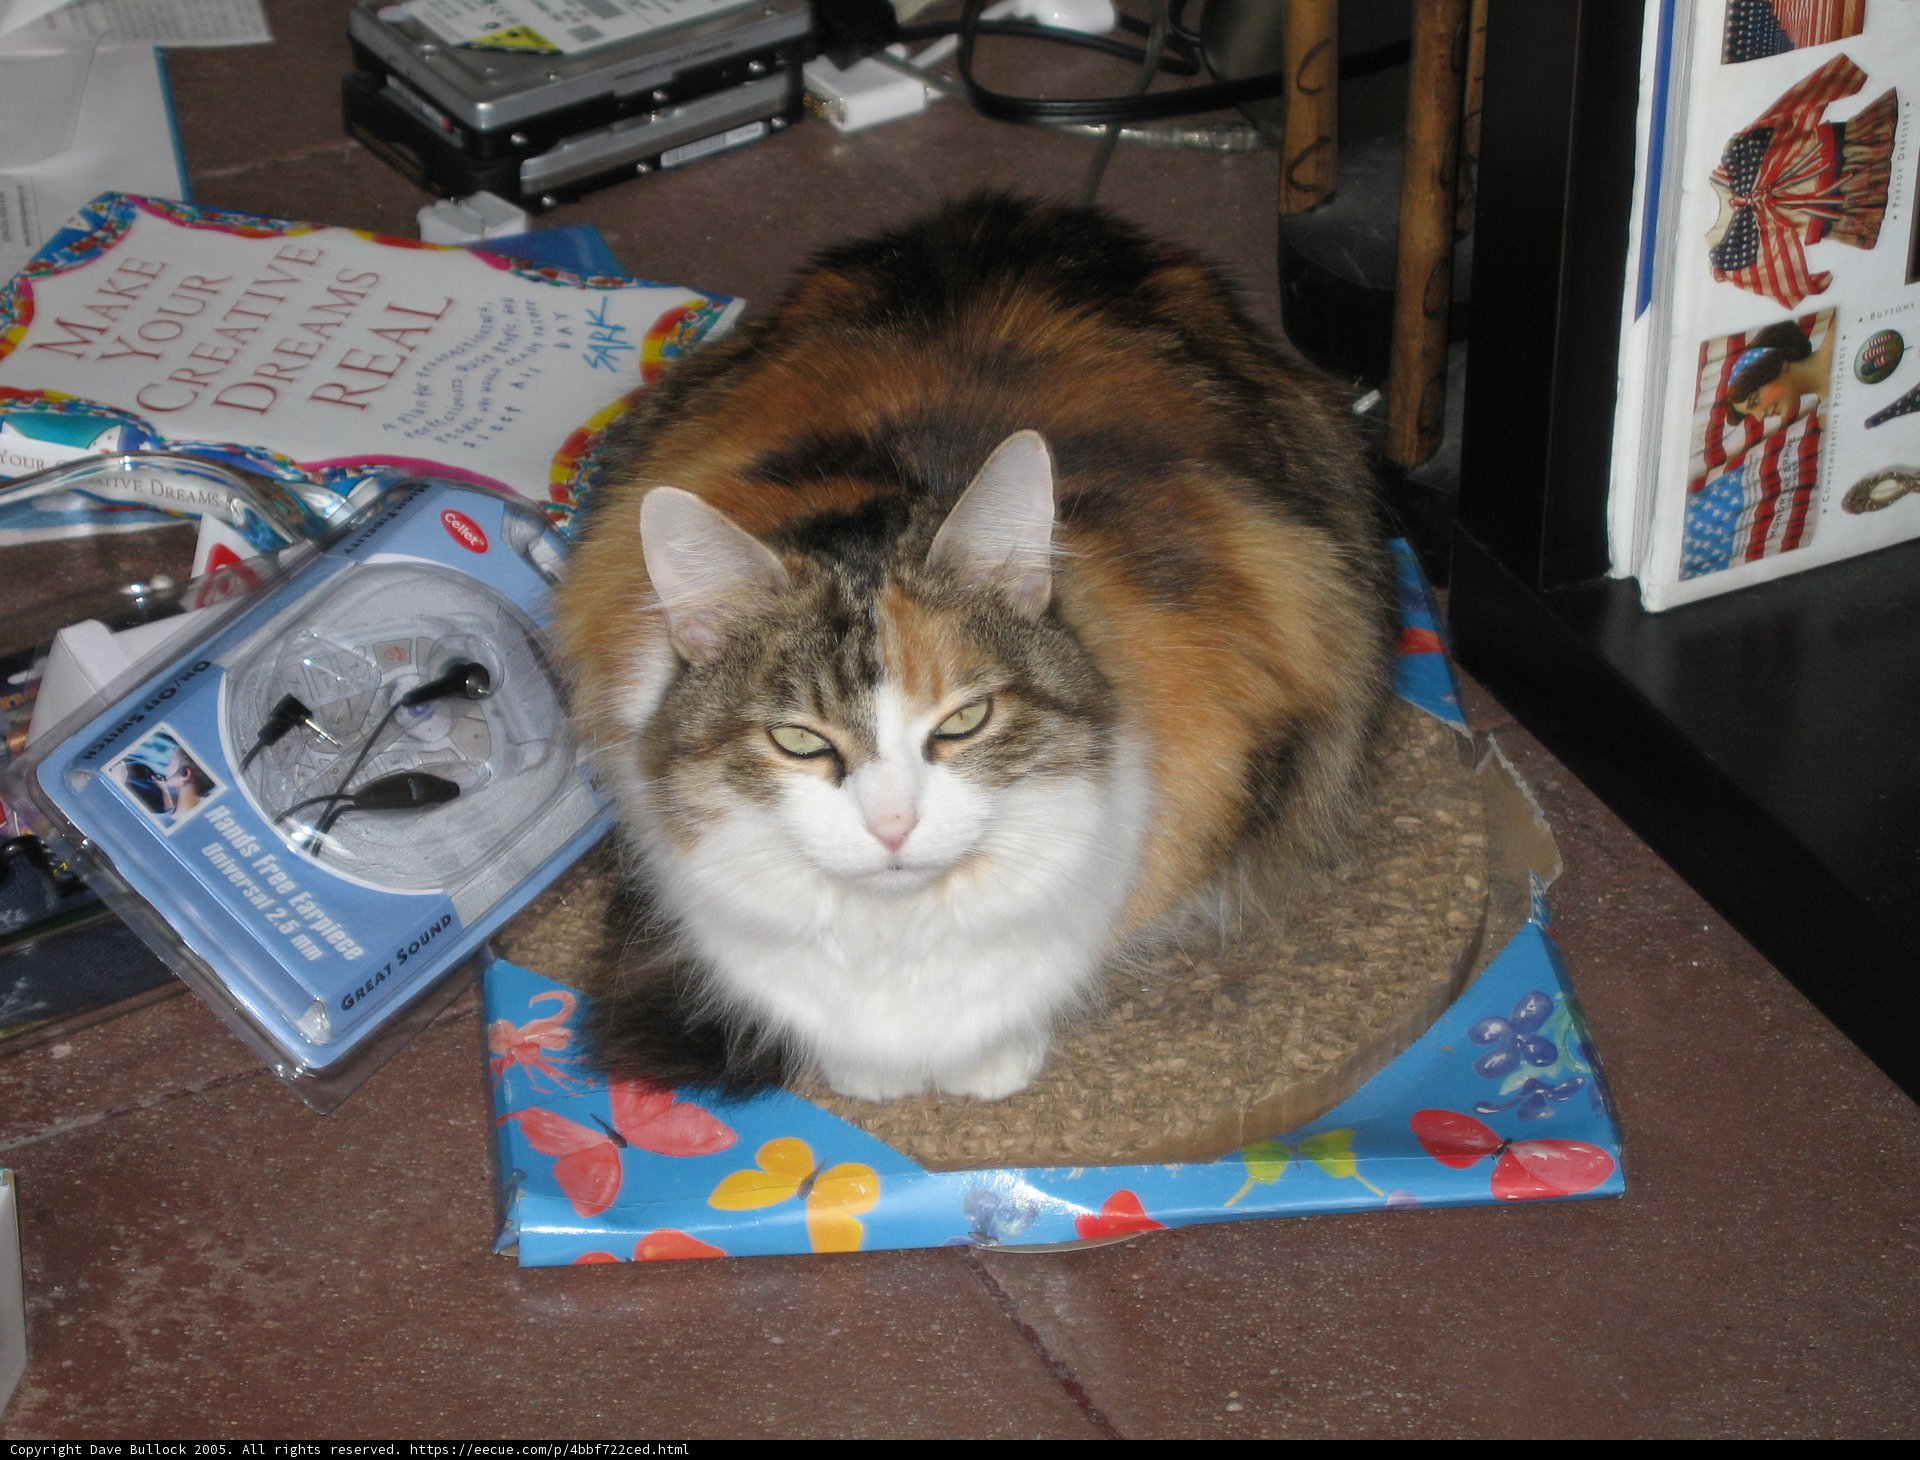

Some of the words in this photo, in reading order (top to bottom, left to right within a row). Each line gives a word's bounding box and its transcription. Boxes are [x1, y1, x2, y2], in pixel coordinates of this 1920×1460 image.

[1898, 113, 1910, 160] DRESSES
[30, 257, 167, 360] MAKE
[96, 275, 234, 361] YOUR
[136, 244, 323, 412] CREATIVE
[211, 268, 380, 415] DREAMS
[307, 297, 456, 410] REAL
[583, 296, 635, 373] SARK
[1870, 303, 1915, 320] BUTTONS
[1823, 414, 1840, 502] COMMEMORATIVE
[1833, 345, 1847, 407] POSTCARDS
[150, 479, 220, 507] DREAMS
[144, 660, 211, 712] ON/OFF
[82, 713, 145, 761] SWITCH
[201, 842, 276, 910] Universal
[264, 907, 300, 934] 2.5
[290, 933, 323, 961] mm
[204, 804, 260, 858] Hands
[251, 853, 296, 895] Free
[288, 891, 364, 961] Earpiece
[340, 964, 392, 1011] GREAT
[395, 913, 452, 967] SOUND
